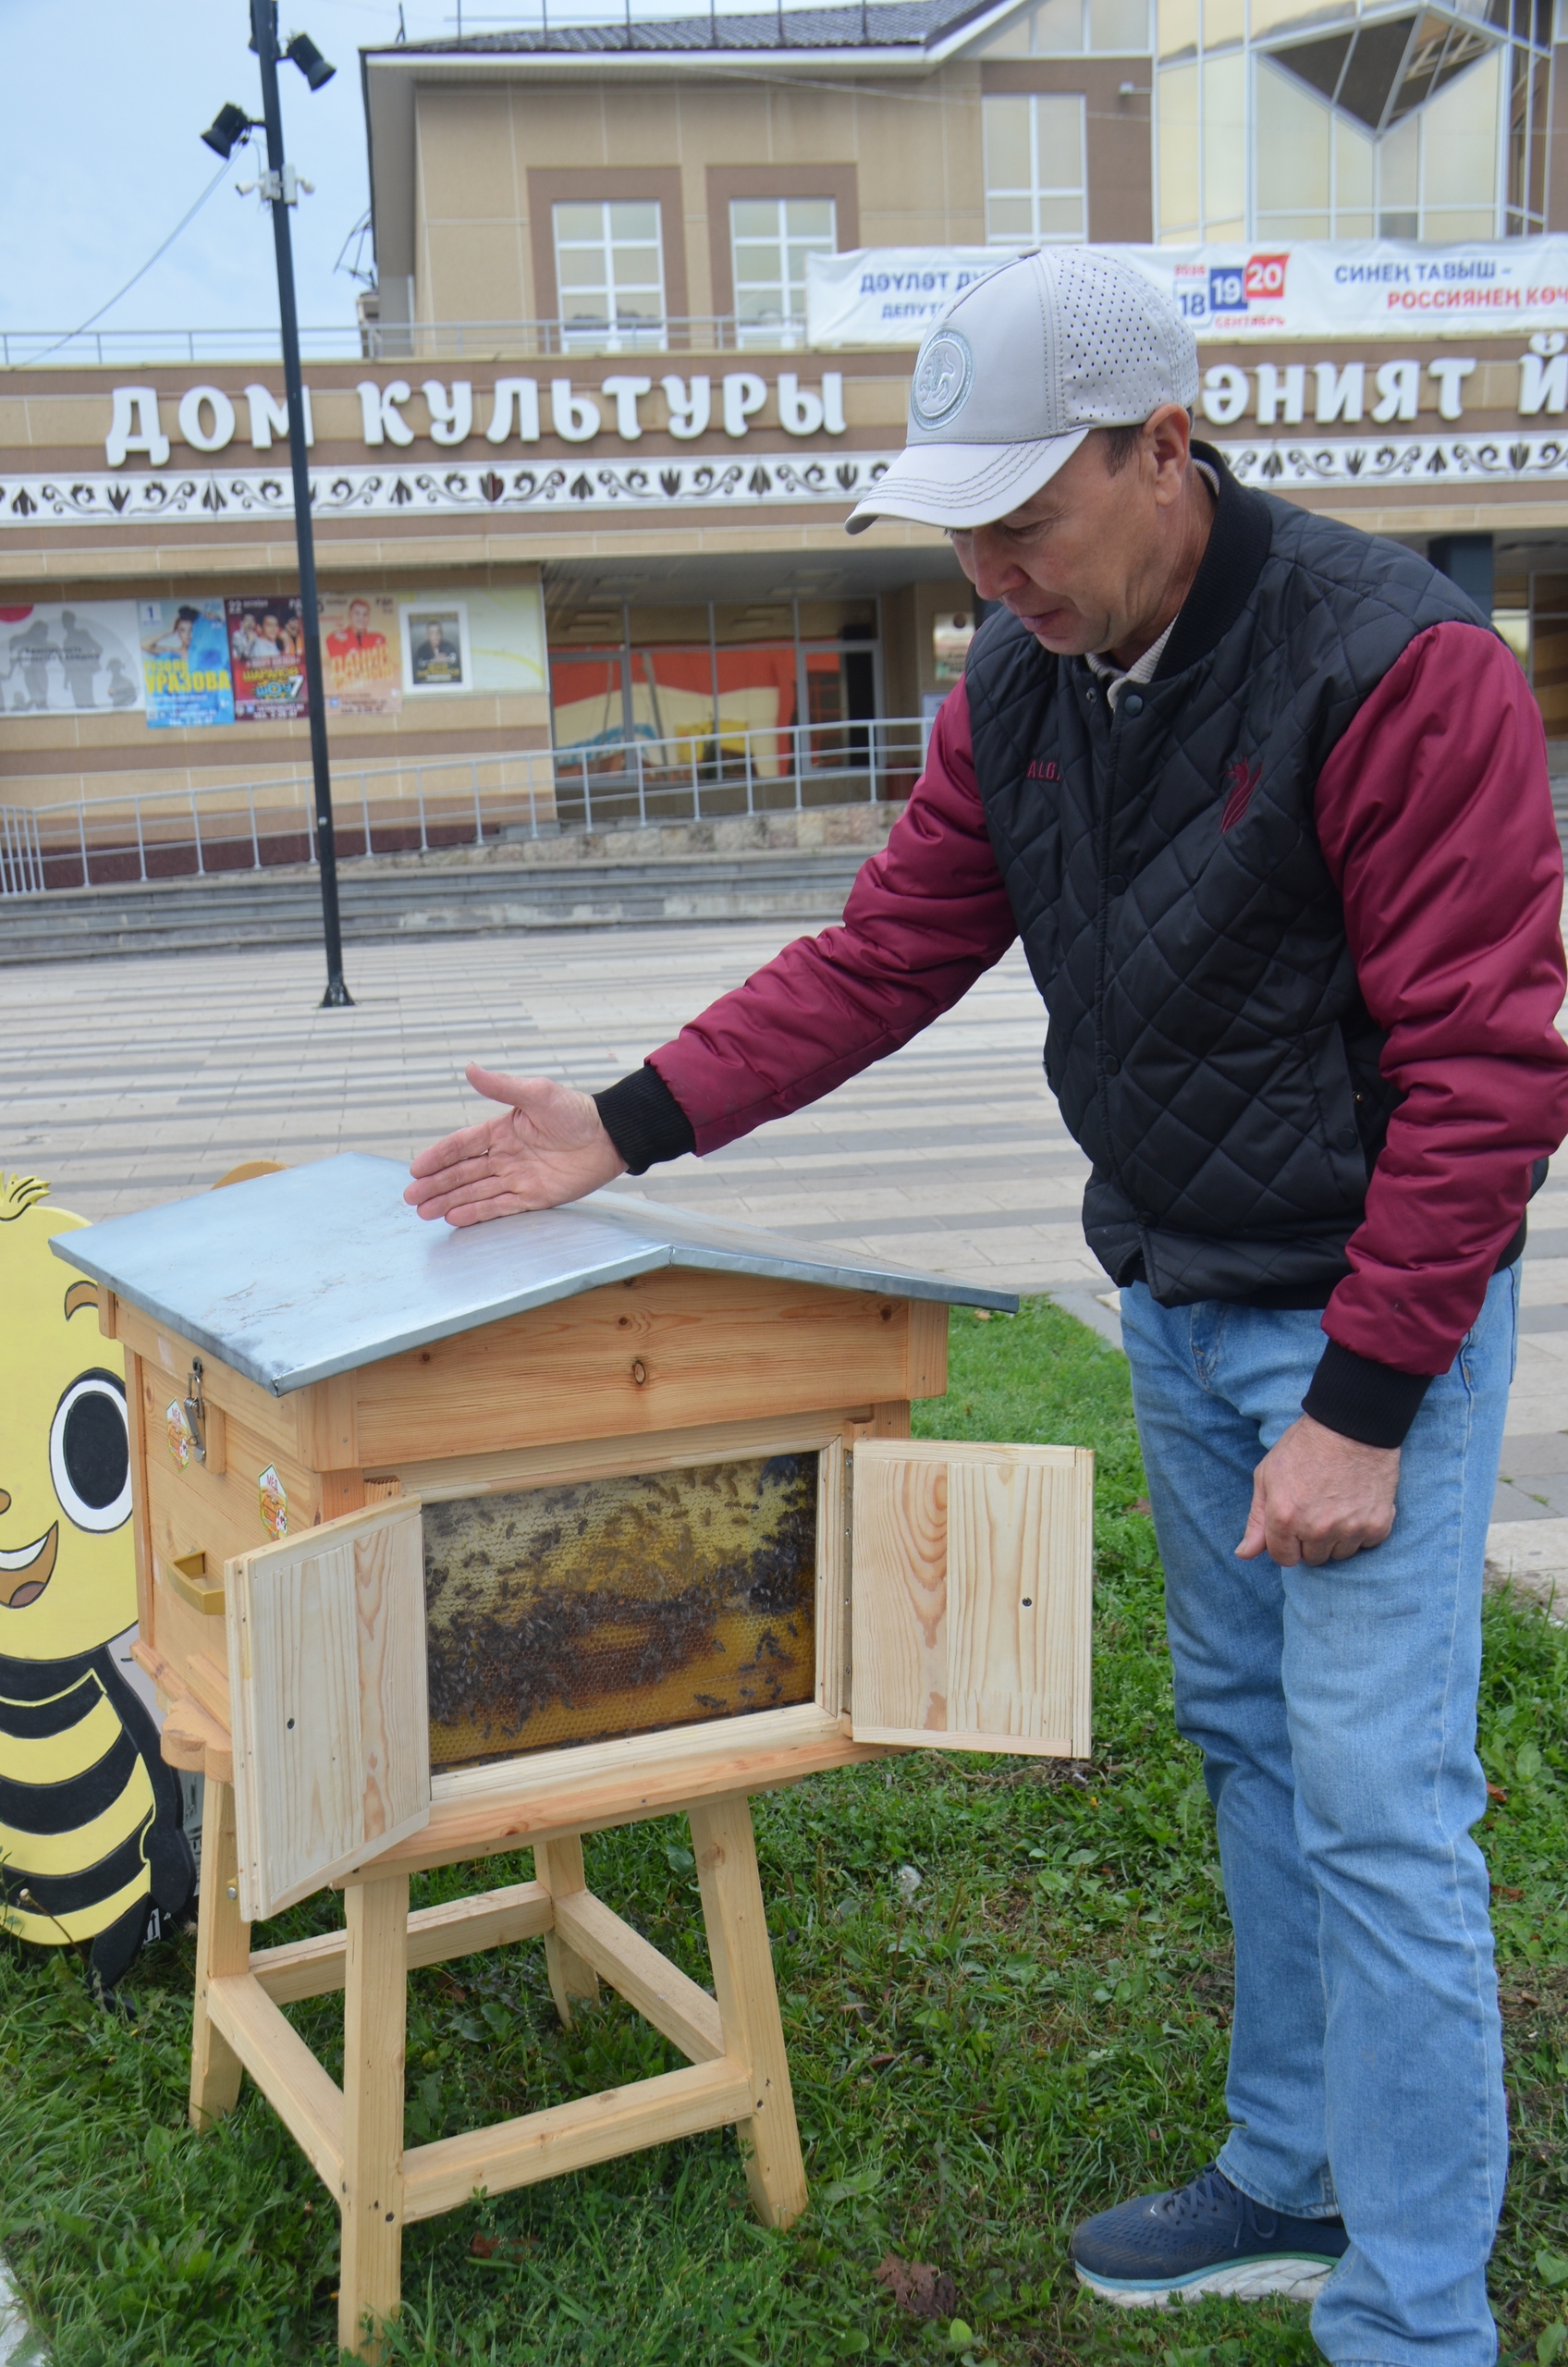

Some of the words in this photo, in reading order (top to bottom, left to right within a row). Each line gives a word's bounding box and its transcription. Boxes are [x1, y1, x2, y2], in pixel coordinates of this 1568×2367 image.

[1247, 263, 1282, 291] 20
[1334, 263, 1411, 283] СИНЕҢ
[1415, 261, 1496, 281] ТАВЫШ
[1211, 276, 1242, 305] 19
[1388, 289, 1521, 310] РОССИЯНЕҢ
[881, 302, 944, 320] ДЕПУТ
[1180, 293, 1205, 316] 18
[1215, 315, 1284, 328] СЕНТЯБРЬ
[105, 384, 314, 467] ДОМ
[357, 372, 848, 447] КУЛЬТУРЫ
[145, 669, 231, 693] УРАЗОВА
[288, 675, 304, 697] 7
